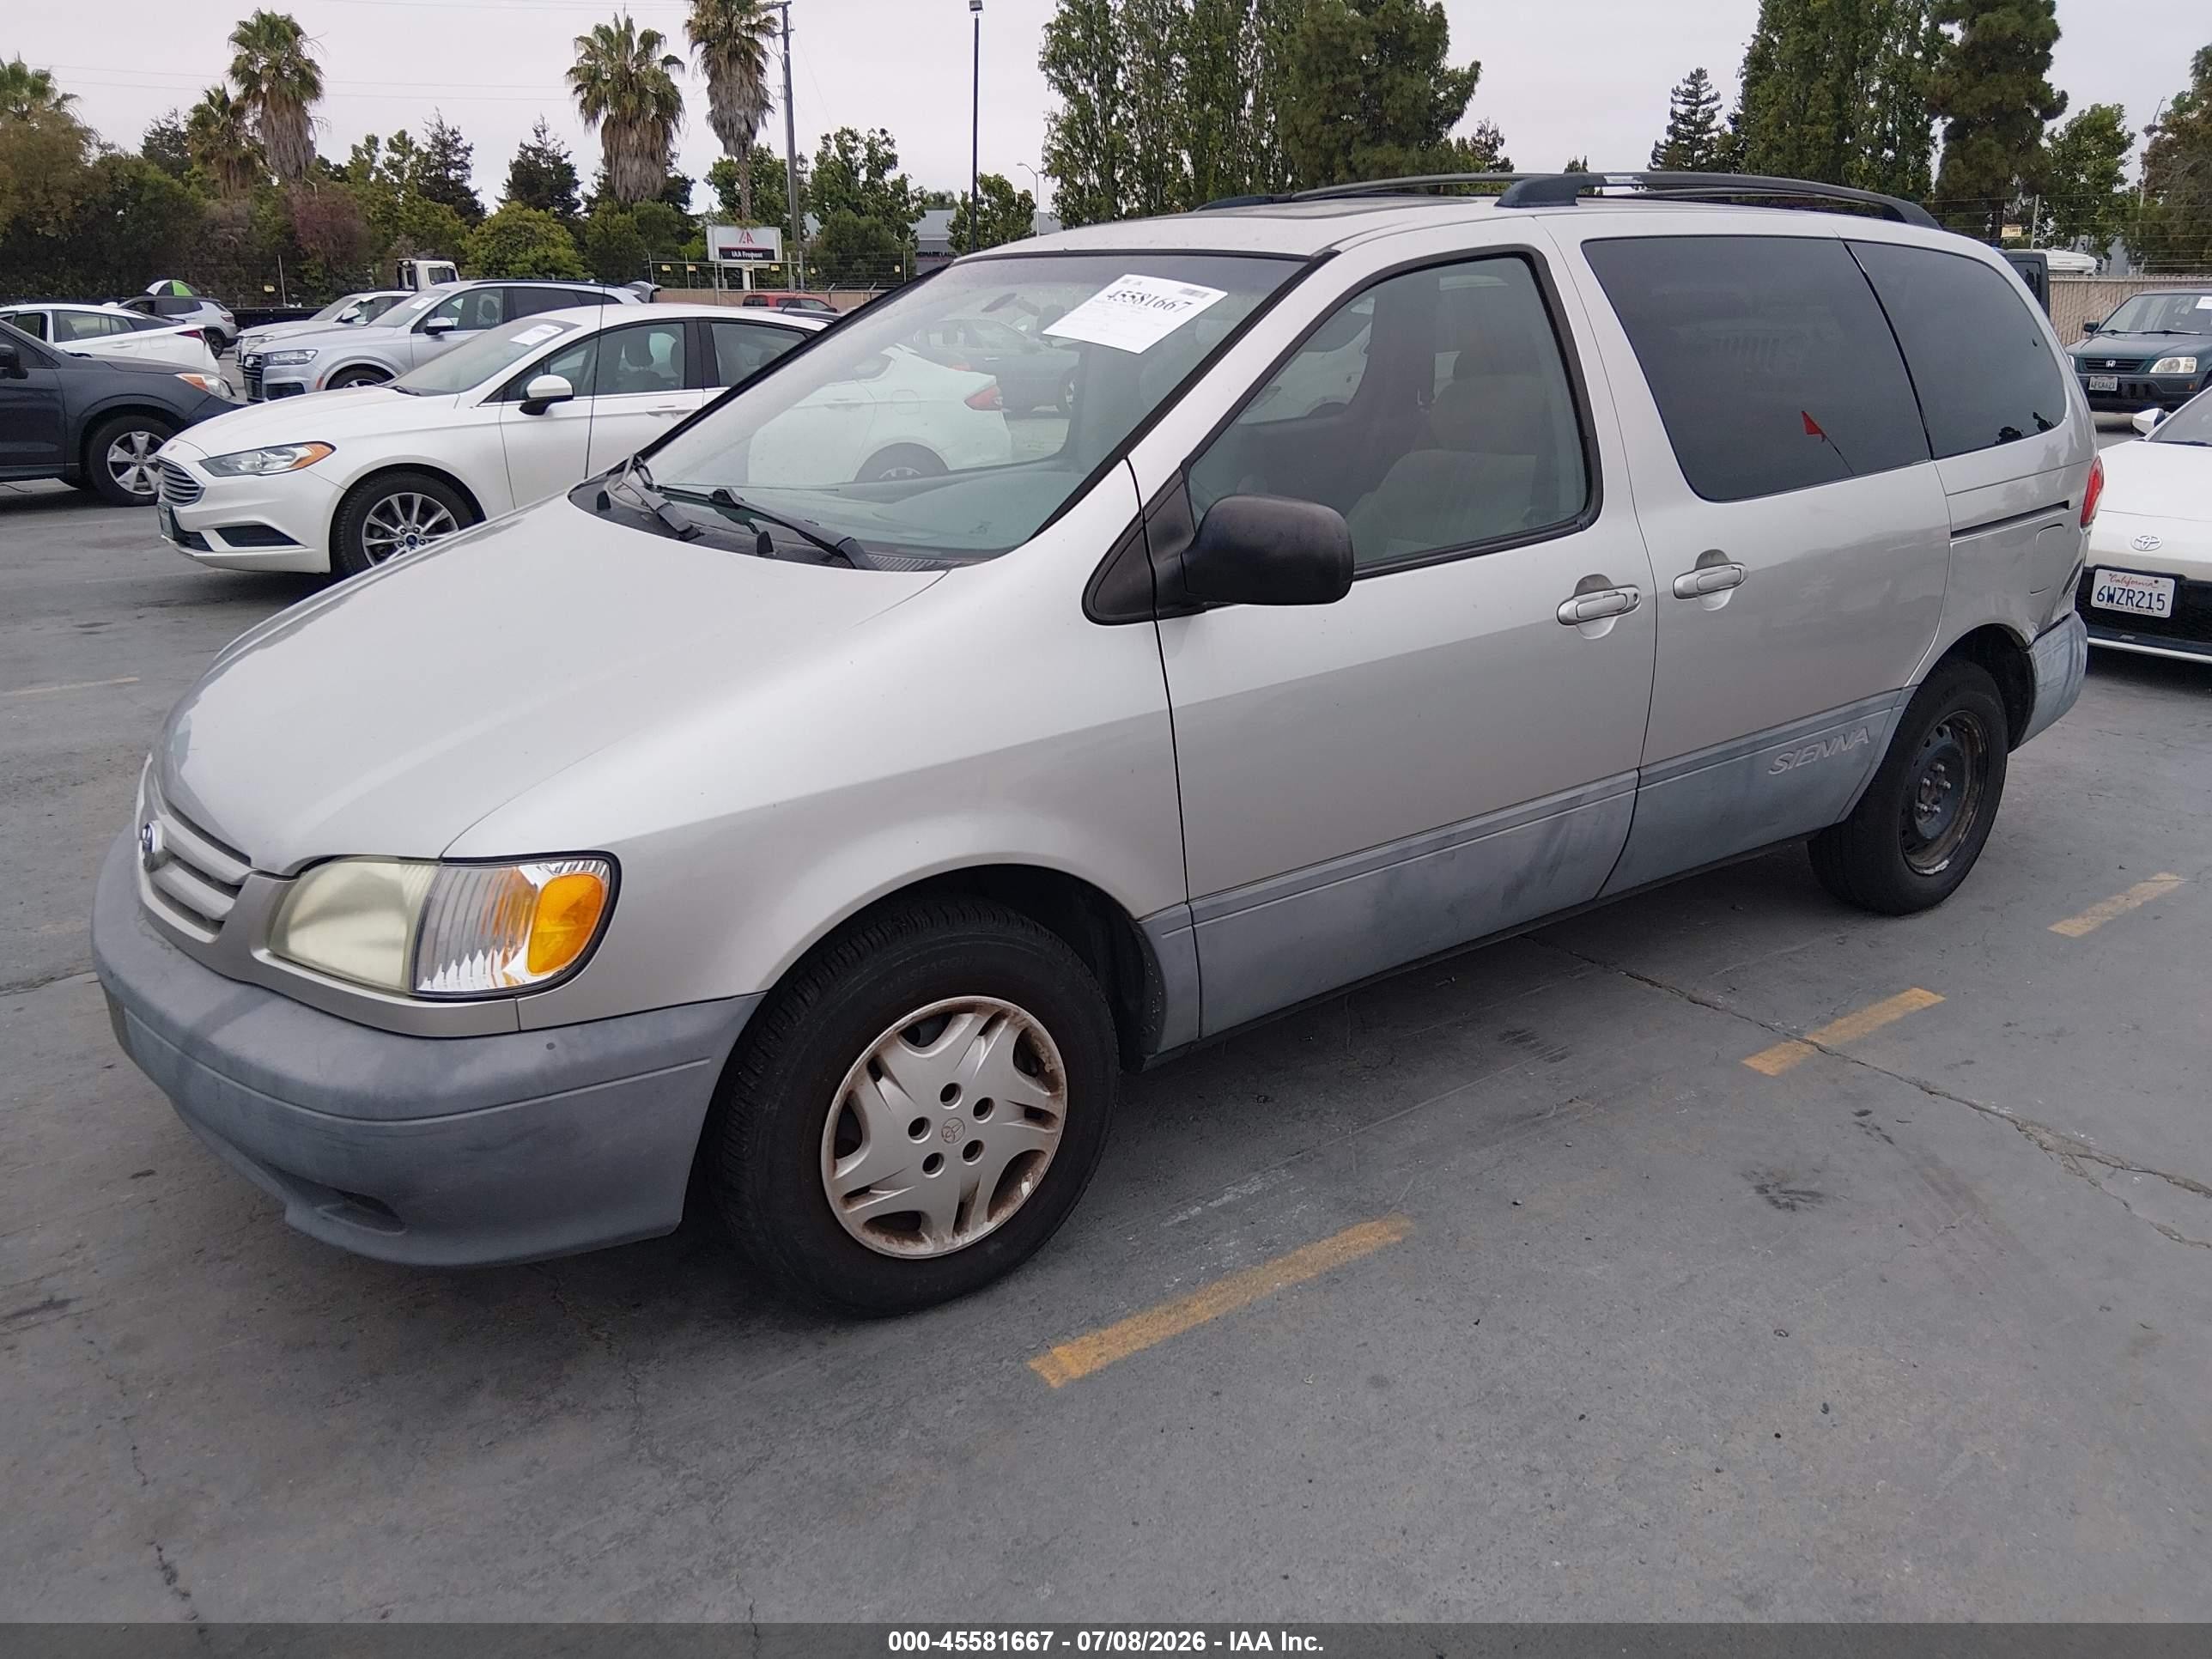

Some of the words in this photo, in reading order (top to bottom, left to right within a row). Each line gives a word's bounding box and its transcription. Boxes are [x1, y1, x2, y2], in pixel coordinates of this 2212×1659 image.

[1106, 289, 1194, 313] 45581667
[2110, 574, 2157, 588] California
[2097, 586, 2166, 611] 6WZR215
[1768, 726, 1870, 775] SIENNA
